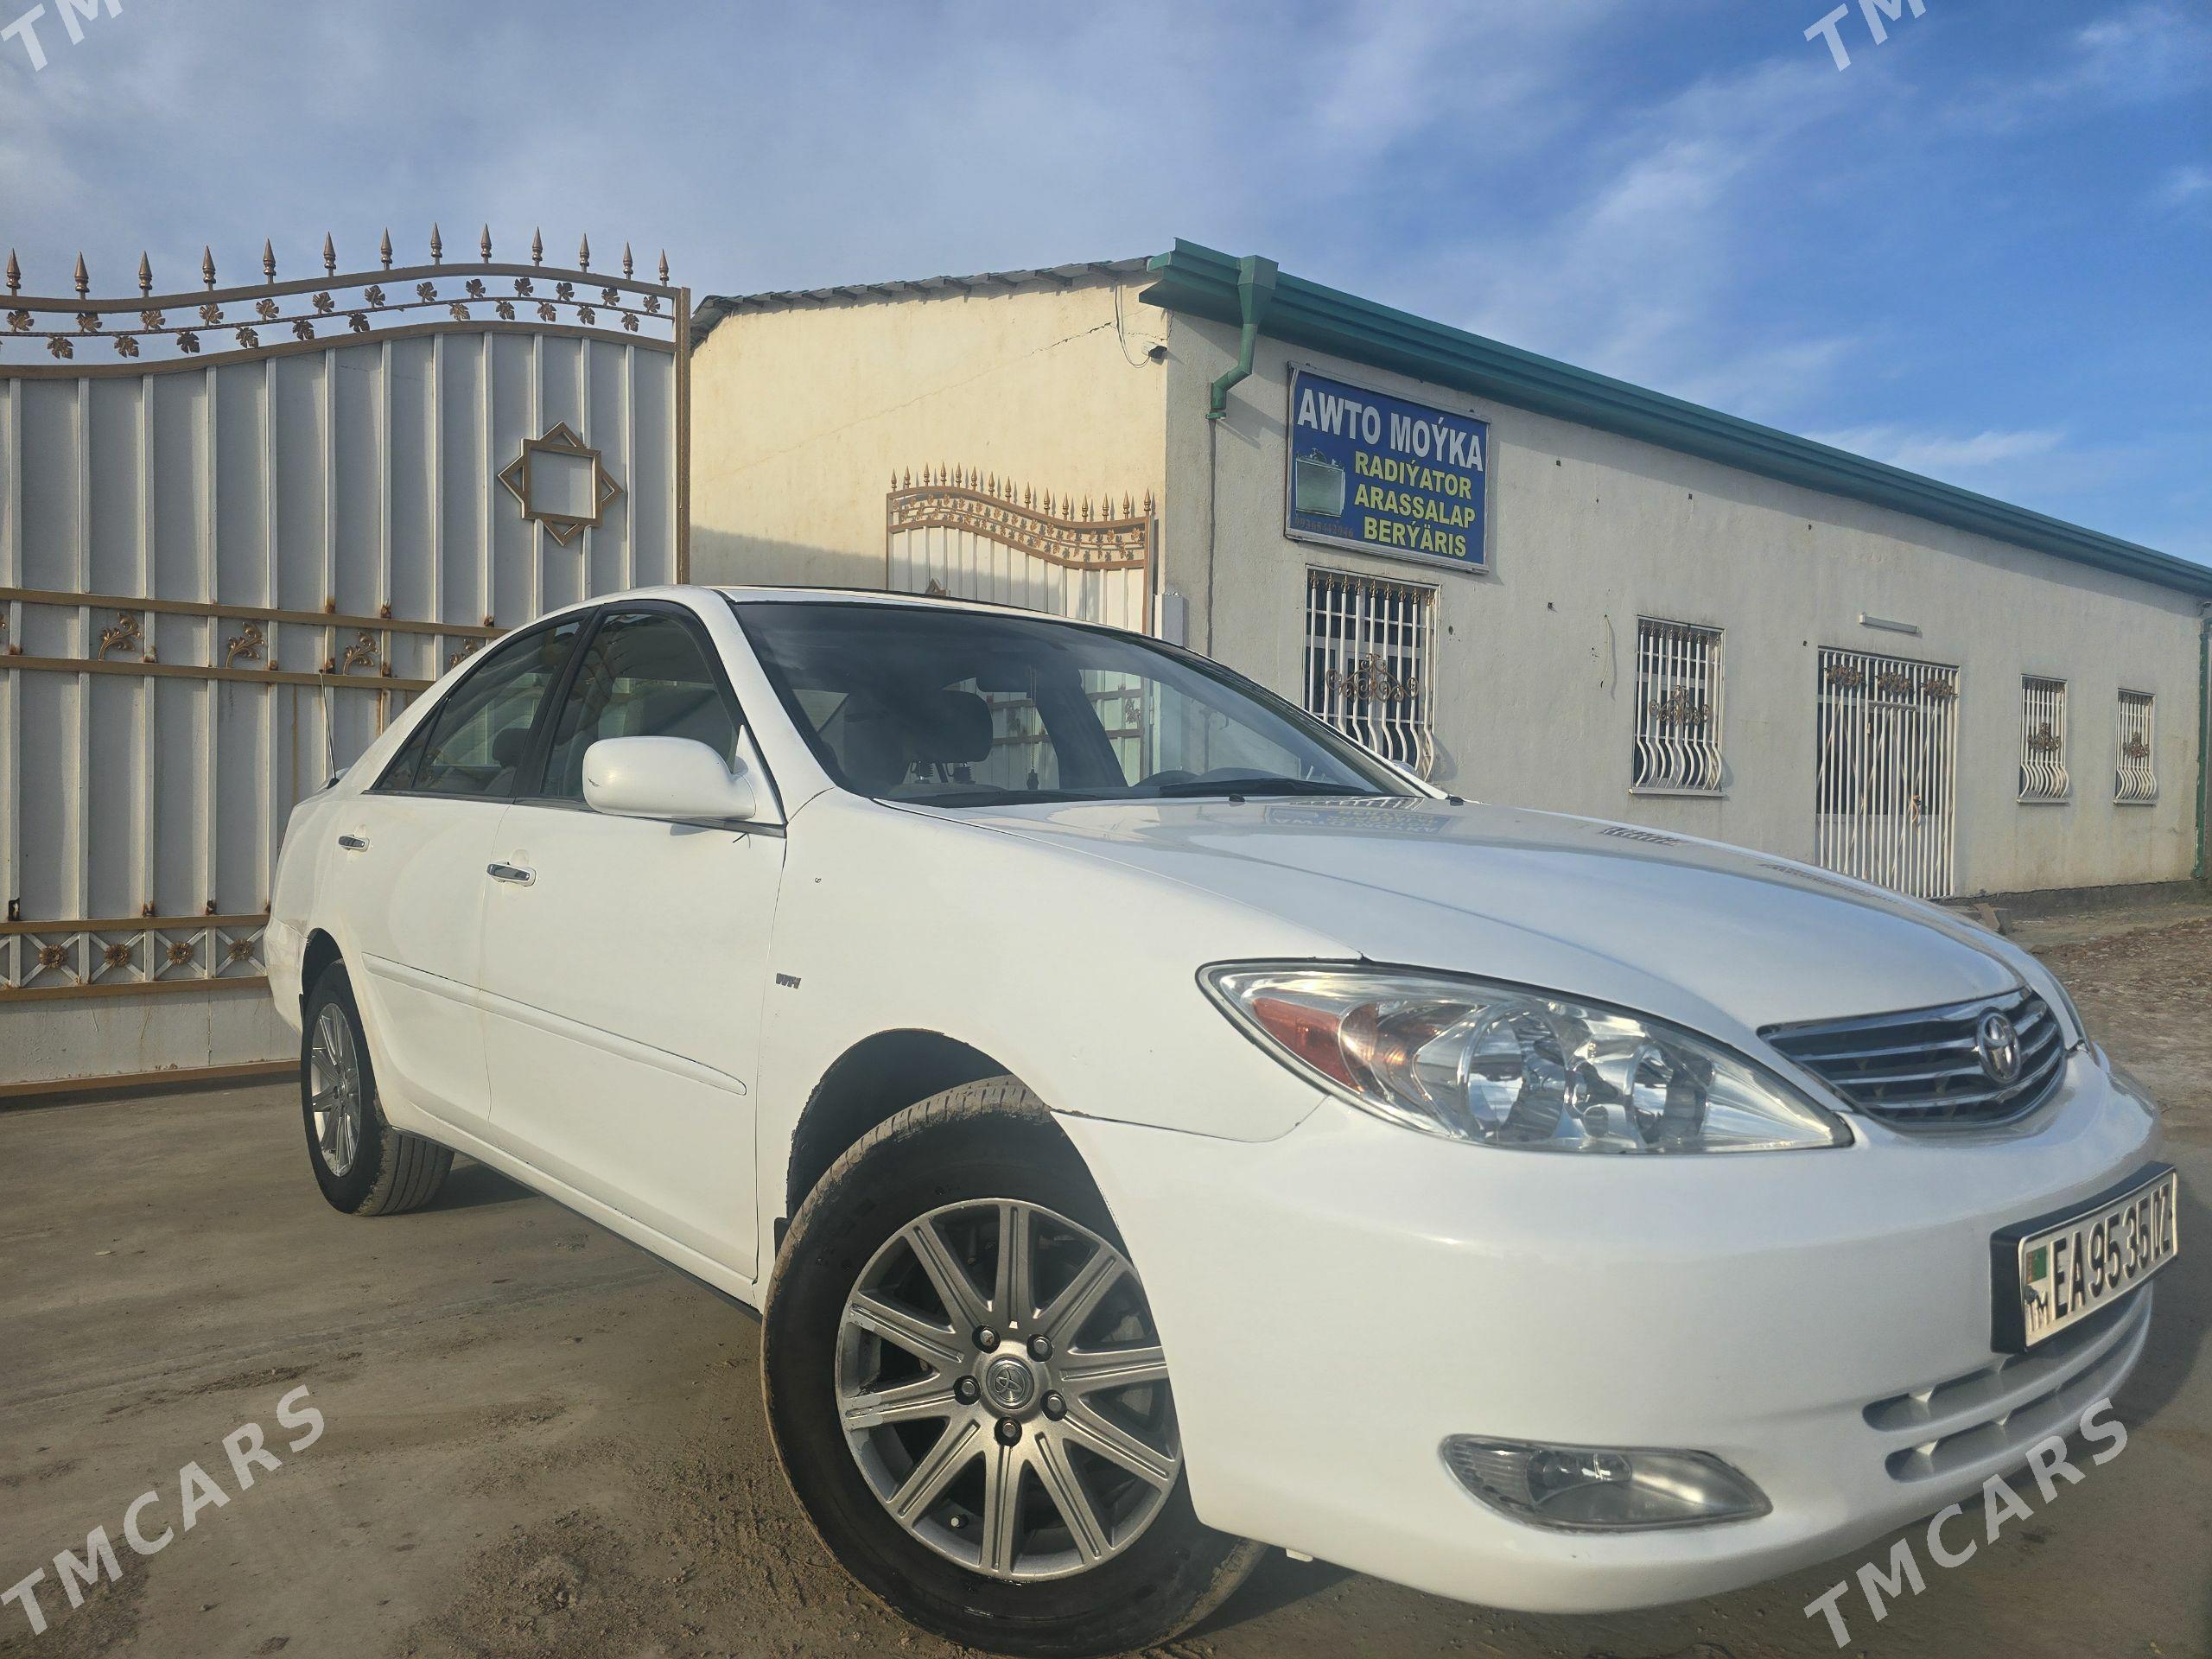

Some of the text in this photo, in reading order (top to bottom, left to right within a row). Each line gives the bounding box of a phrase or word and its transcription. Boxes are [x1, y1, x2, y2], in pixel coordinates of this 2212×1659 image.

[1297, 388, 1484, 472] AWTO MOÝKA
[1354, 450, 1471, 500] RADIÝATOR
[1354, 483, 1476, 529] ARASSALAP
[1363, 516, 1466, 557] BERÝÄRIS
